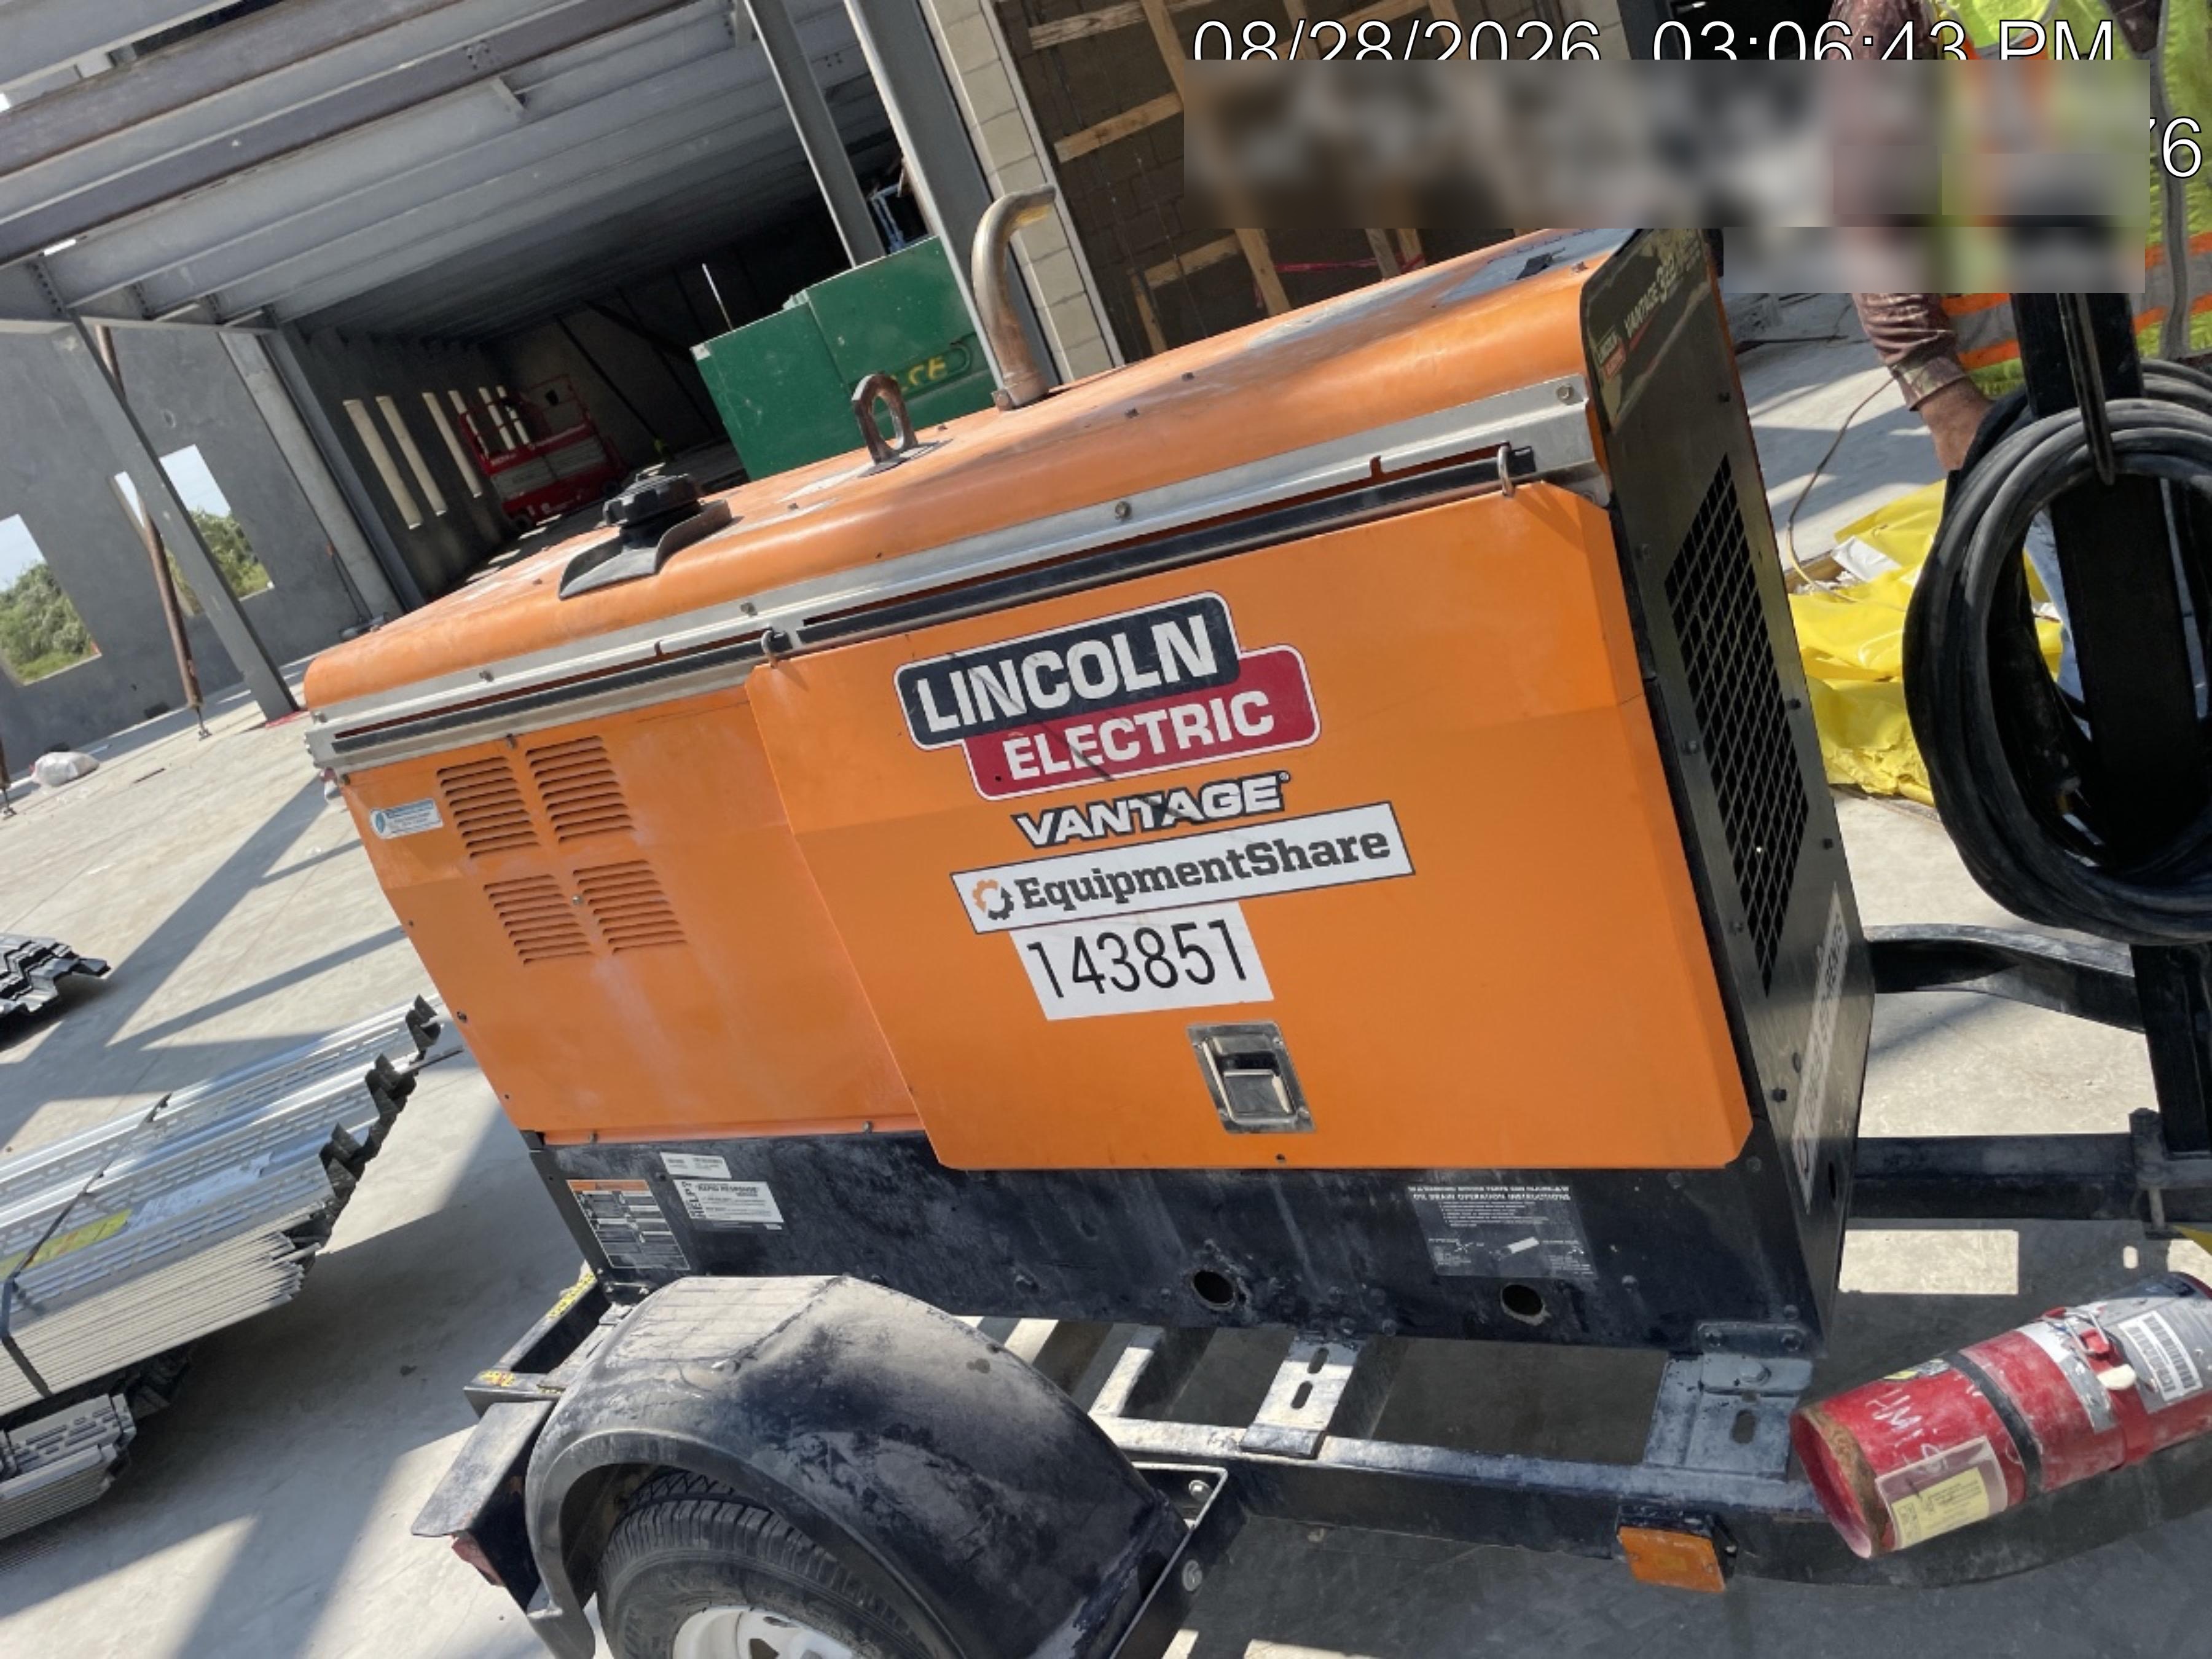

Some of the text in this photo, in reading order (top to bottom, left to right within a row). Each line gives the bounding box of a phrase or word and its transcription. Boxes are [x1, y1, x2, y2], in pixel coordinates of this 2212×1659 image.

[917, 614, 1218, 733] LINCOLN
[1003, 690, 1275, 781] ELECTRIC
[1014, 830, 1390, 912] EquipmentShare
[1027, 918, 1247, 998] 143851
